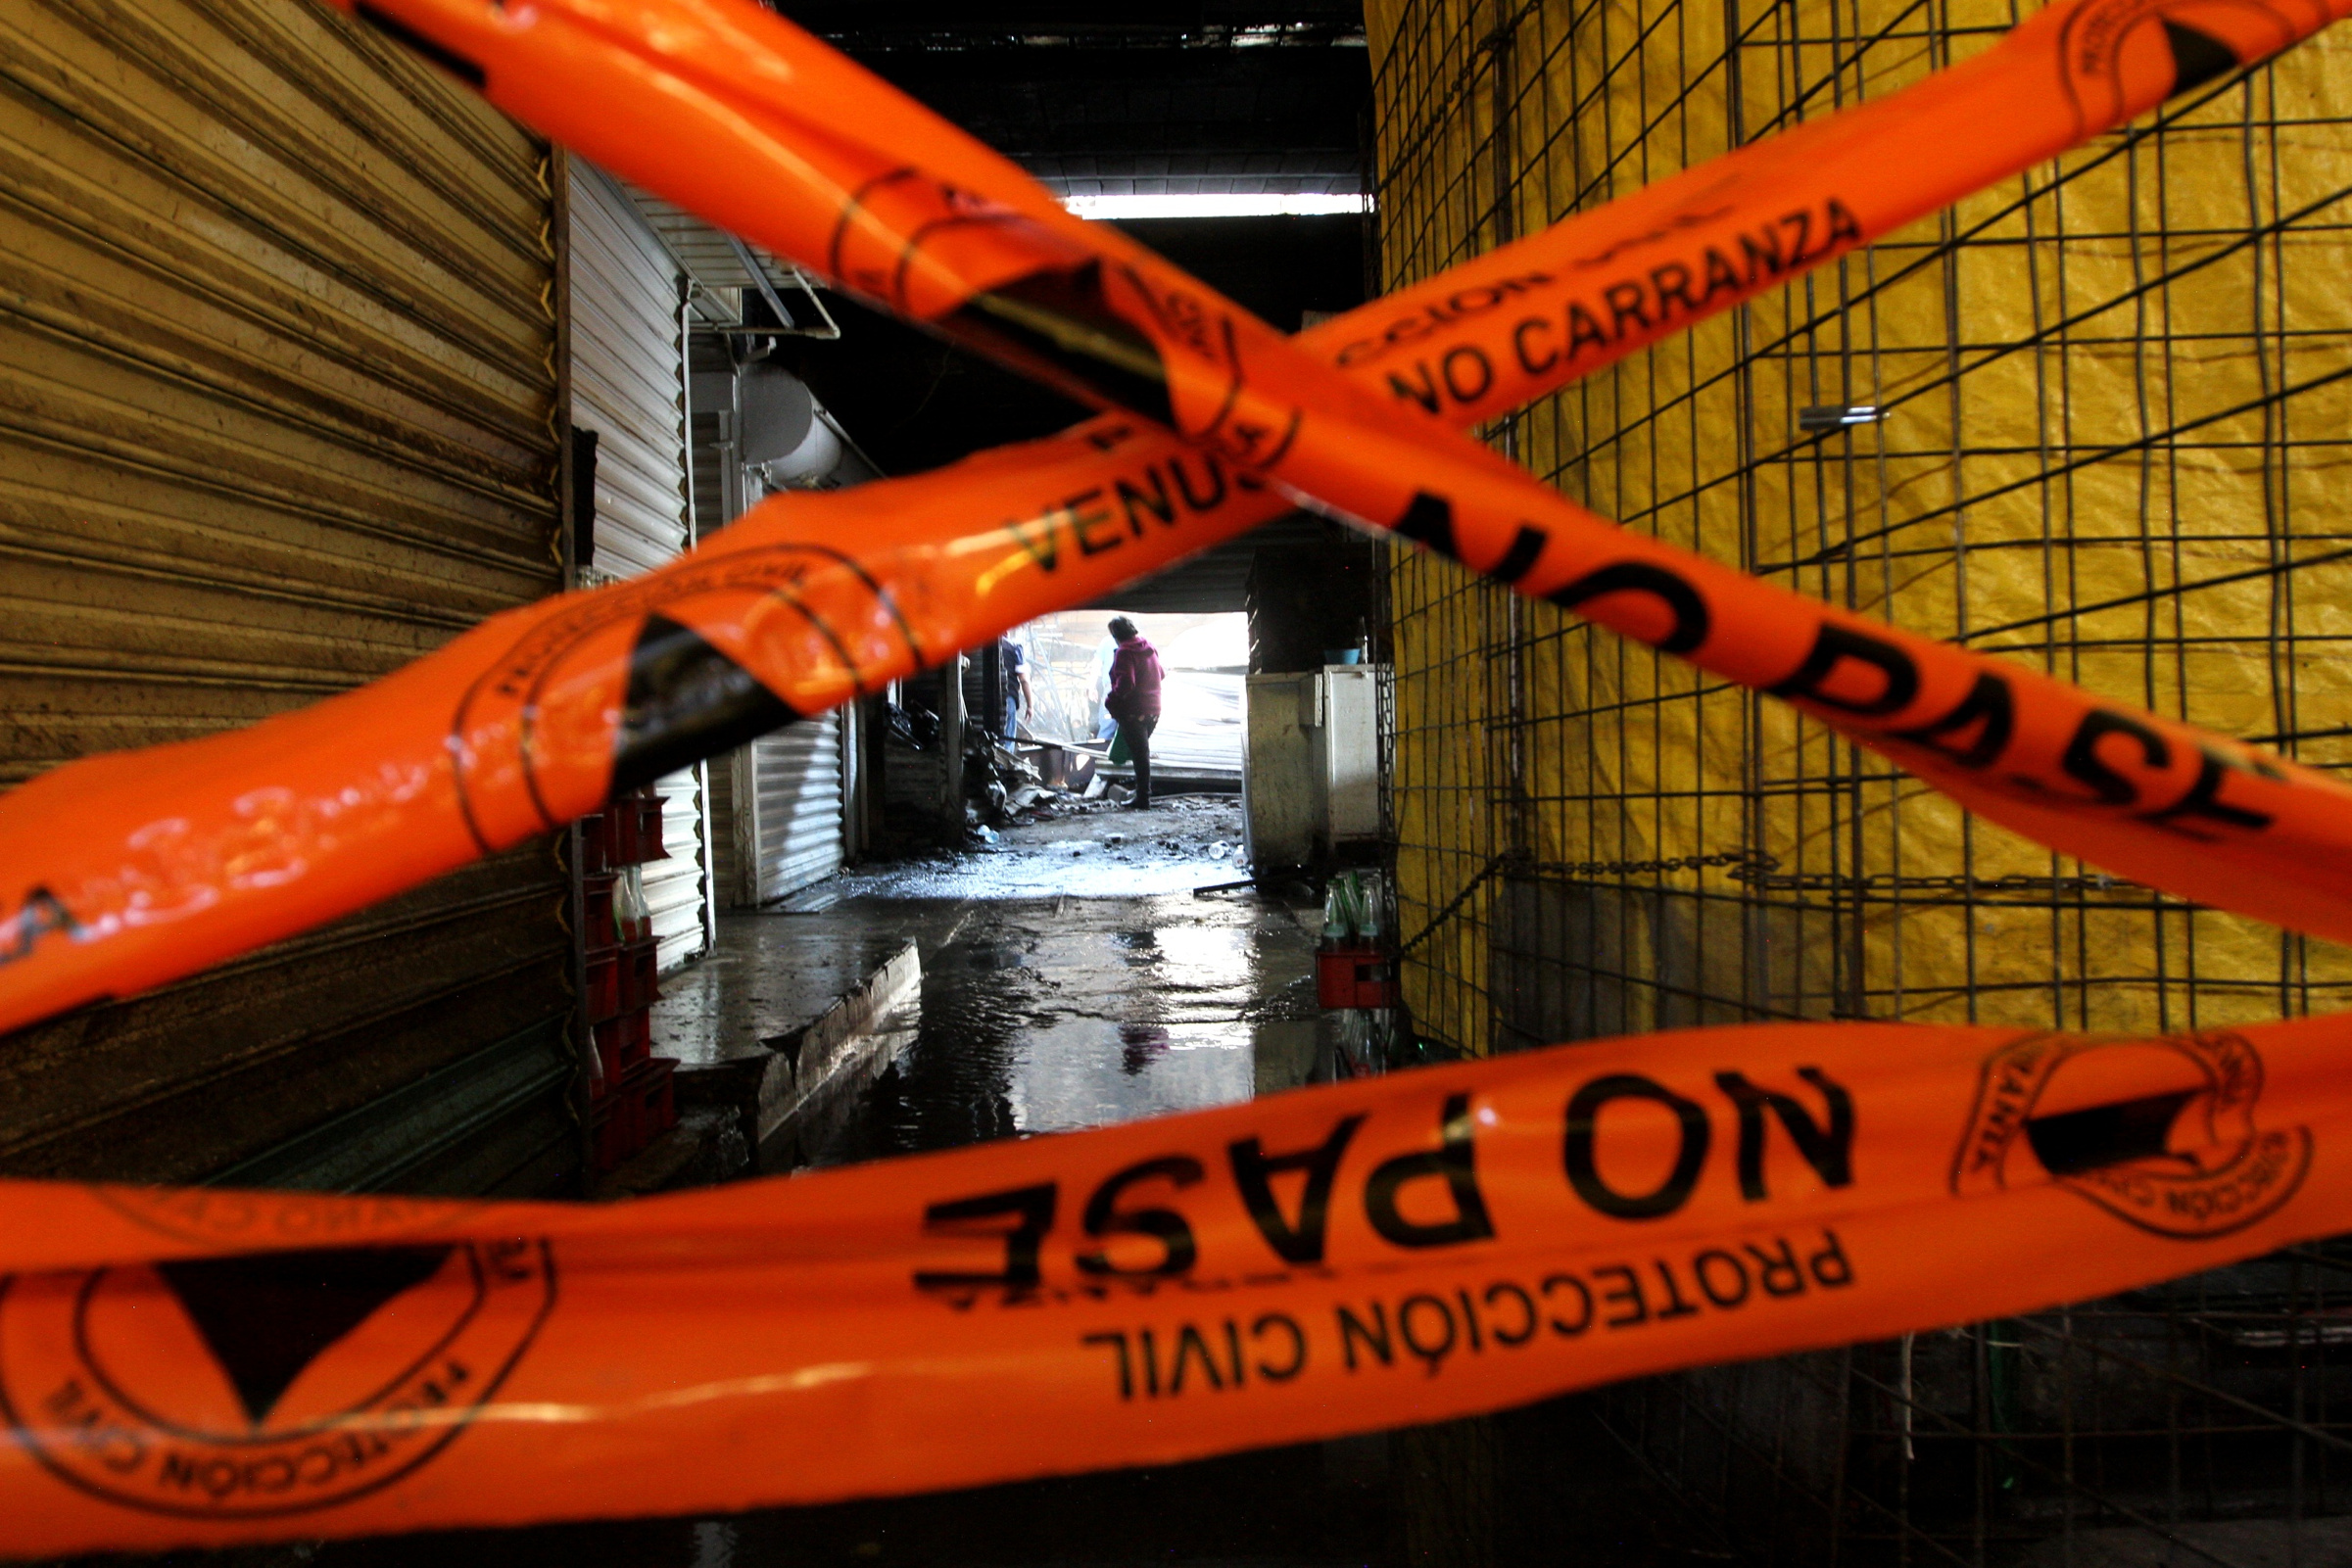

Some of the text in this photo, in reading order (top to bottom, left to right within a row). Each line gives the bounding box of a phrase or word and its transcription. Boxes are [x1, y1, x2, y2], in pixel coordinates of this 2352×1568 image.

[1512, 196, 1861, 378] CARRANZA
[913, 1066, 1854, 1286] NO PASE
[1083, 1230, 1854, 1402] PROTECCIÓN CIVIL
